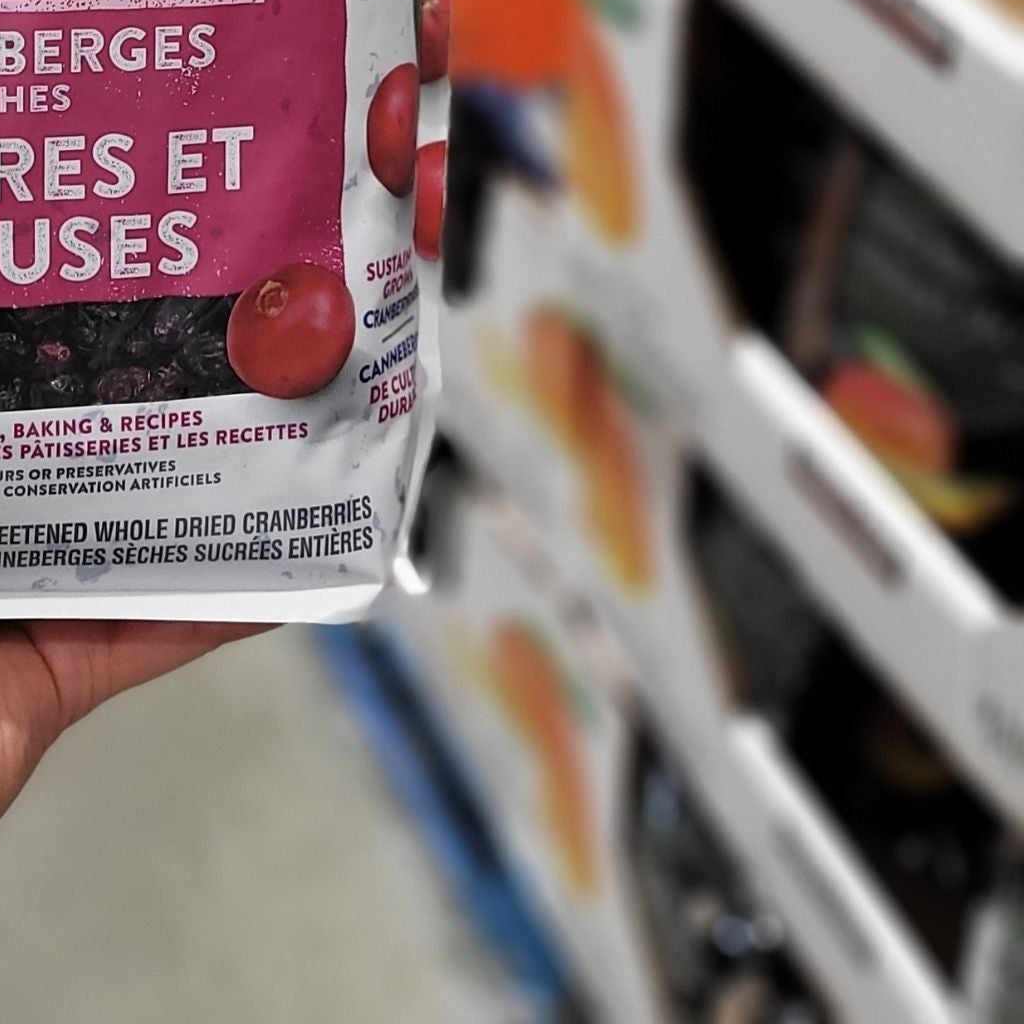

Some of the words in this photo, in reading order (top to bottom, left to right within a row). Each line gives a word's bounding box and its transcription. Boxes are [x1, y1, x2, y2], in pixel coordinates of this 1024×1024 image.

[166, 125, 255, 195] ET
[370, 381, 389, 404] DE
[13, 418, 92, 438] BAKING
[100, 416, 113, 433] &
[121, 410, 203, 432] RECIPES
[20, 436, 142, 460] PÂTISSERIES
[148, 435, 170, 452] ET
[177, 431, 209, 450] LES
[216, 422, 309, 446] RECETTES
[3, 479, 126, 498] CONSERVATION
[130, 472, 222, 492] ARTIFICIELS
[28, 468, 52, 480] OR
[56, 460, 177, 479] PRESERVATIVES
[94, 518, 168, 543] WHOLE
[175, 513, 236, 538] DRIED
[243, 495, 372, 534] CRANBERRIES
[112, 538, 188, 565] SÈCHES
[194, 535, 283, 562] SUCRÉES
[288, 526, 374, 559] ENTIÈRES
